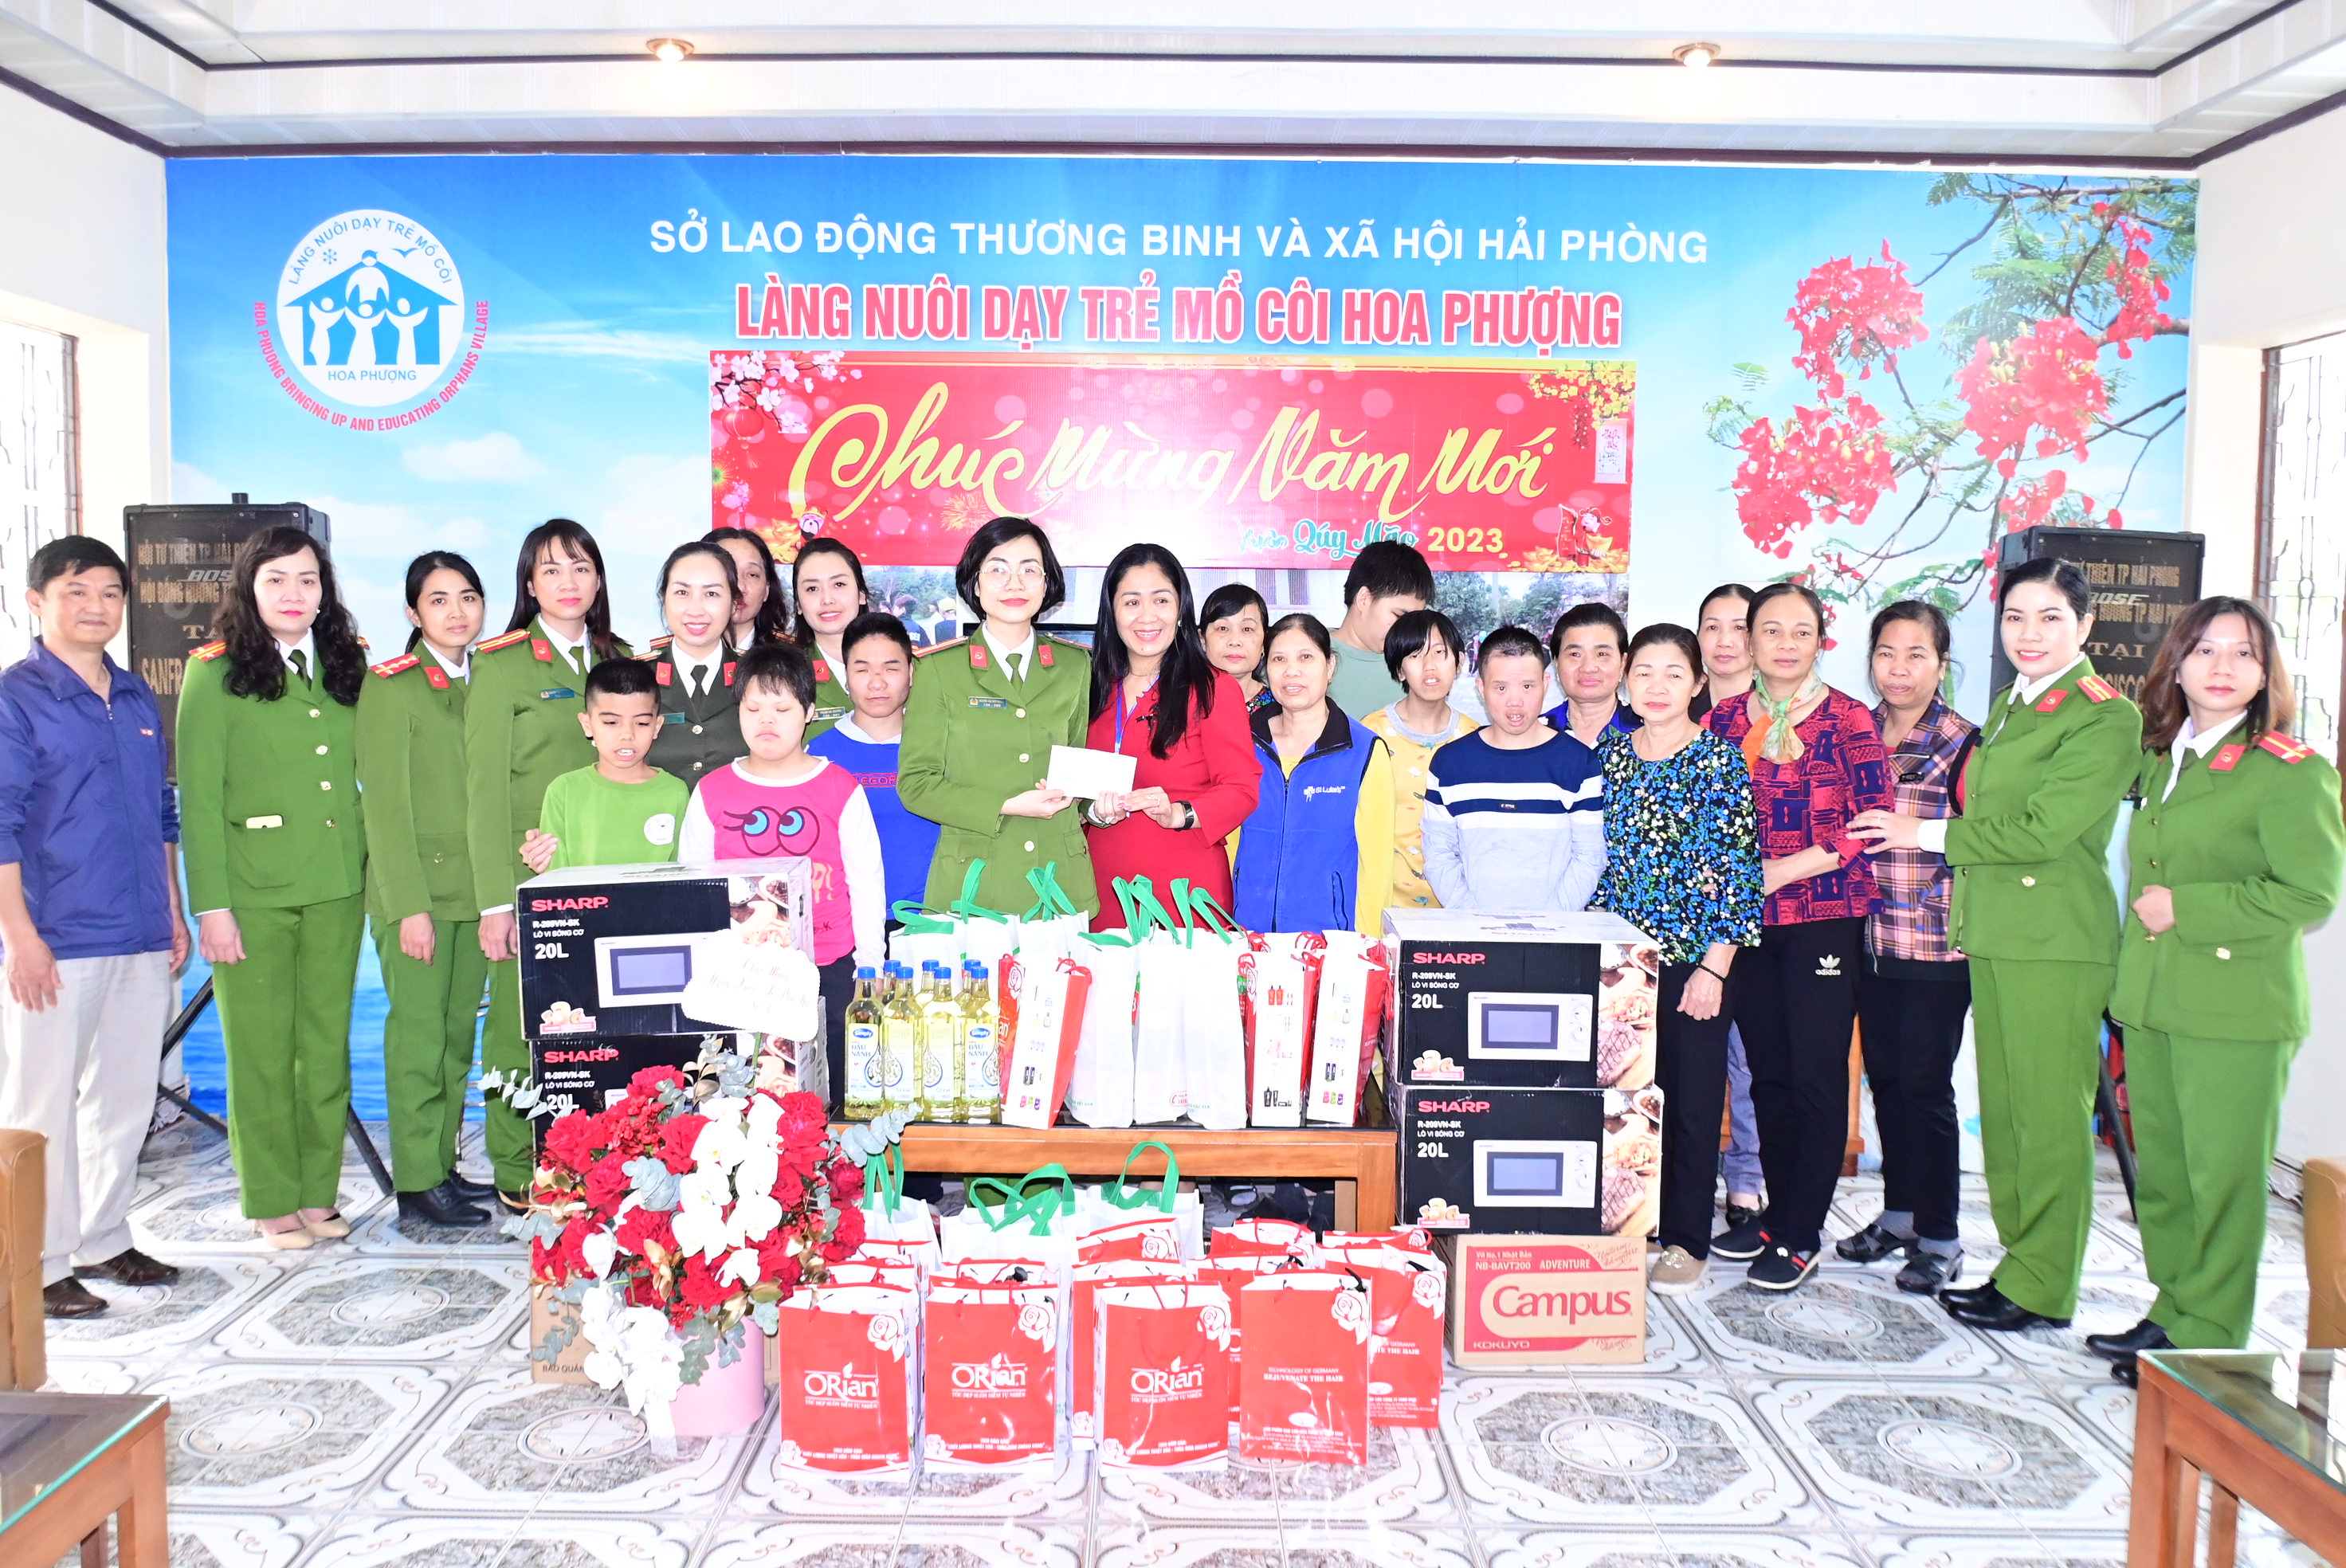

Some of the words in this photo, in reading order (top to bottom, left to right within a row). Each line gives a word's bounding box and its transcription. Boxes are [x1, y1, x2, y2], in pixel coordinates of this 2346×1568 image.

[650, 209, 708, 255] SỞ
[721, 220, 804, 253] LAO
[815, 214, 936, 261] ĐỘNG
[950, 218, 1127, 257] THƯƠNG
[1142, 224, 1241, 257] BINH
[1256, 217, 1311, 259] VÀ
[1324, 218, 1380, 259] XÃ
[1394, 219, 1463, 267] HỘI
[1478, 216, 1545, 261] HẢI
[1560, 222, 1707, 264] PHÒNG
[288, 246, 315, 284] LÀNG
[314, 221, 348, 247] NUÔI
[351, 218, 382, 232] DẠY
[387, 219, 416, 240] TRẺ
[434, 258, 453, 284] CÔI
[254, 302, 268, 327] HOA
[735, 272, 852, 340] LÀNG
[863, 273, 971, 341] NUÔI
[981, 284, 1070, 352] DẠY
[1079, 268, 1161, 343] TRẺ
[1172, 269, 1245, 343] MỒ
[1255, 276, 1331, 345] CÔI
[1342, 288, 1431, 347] HOA
[1441, 285, 1623, 358] PHƯỢNG
[471, 300, 489, 350] VILLAGE
[257, 329, 286, 379] PHUONG
[328, 370, 356, 382] HOA
[360, 370, 417, 384] PHƯỢNG
[438, 351, 479, 403] ORPHANS
[280, 377, 331, 421] BRINGING
[331, 412, 347, 427] UP
[349, 417, 375, 432] AND
[378, 398, 441, 432] EDUCATING
[788, 381, 1062, 519] Chúc
[1026, 418, 1237, 519] Mừng
[1227, 406, 1430, 523] Năm
[1417, 426, 1557, 500] Mới
[1427, 527, 1504, 554] 2023
[176, 569, 236, 582] BOS
[2087, 642, 2146, 661] TẠI
[532, 896, 609, 912] SHARP
[535, 943, 569, 959] 20L
[1413, 952, 1485, 964] SHARP
[1411, 993, 1443, 1009] 20L
[544, 1049, 619, 1063] SHARP
[547, 1093, 579, 1110] 20L
[1418, 1100, 1490, 1112] SHARP
[1417, 1142, 1450, 1158] 20L
[1475, 1261, 1532, 1271] NB-BAVT200
[1540, 1259, 1591, 1270] ADVENTURE
[1493, 1286, 1632, 1325] Campus
[1473, 1340, 1530, 1350] KOKUYO
[804, 1370, 877, 1400] ORian
[951, 1363, 1026, 1392] ORian
[1131, 1368, 1202, 1395] ORian
[1263, 1373, 1308, 1382] REJUVENATE
